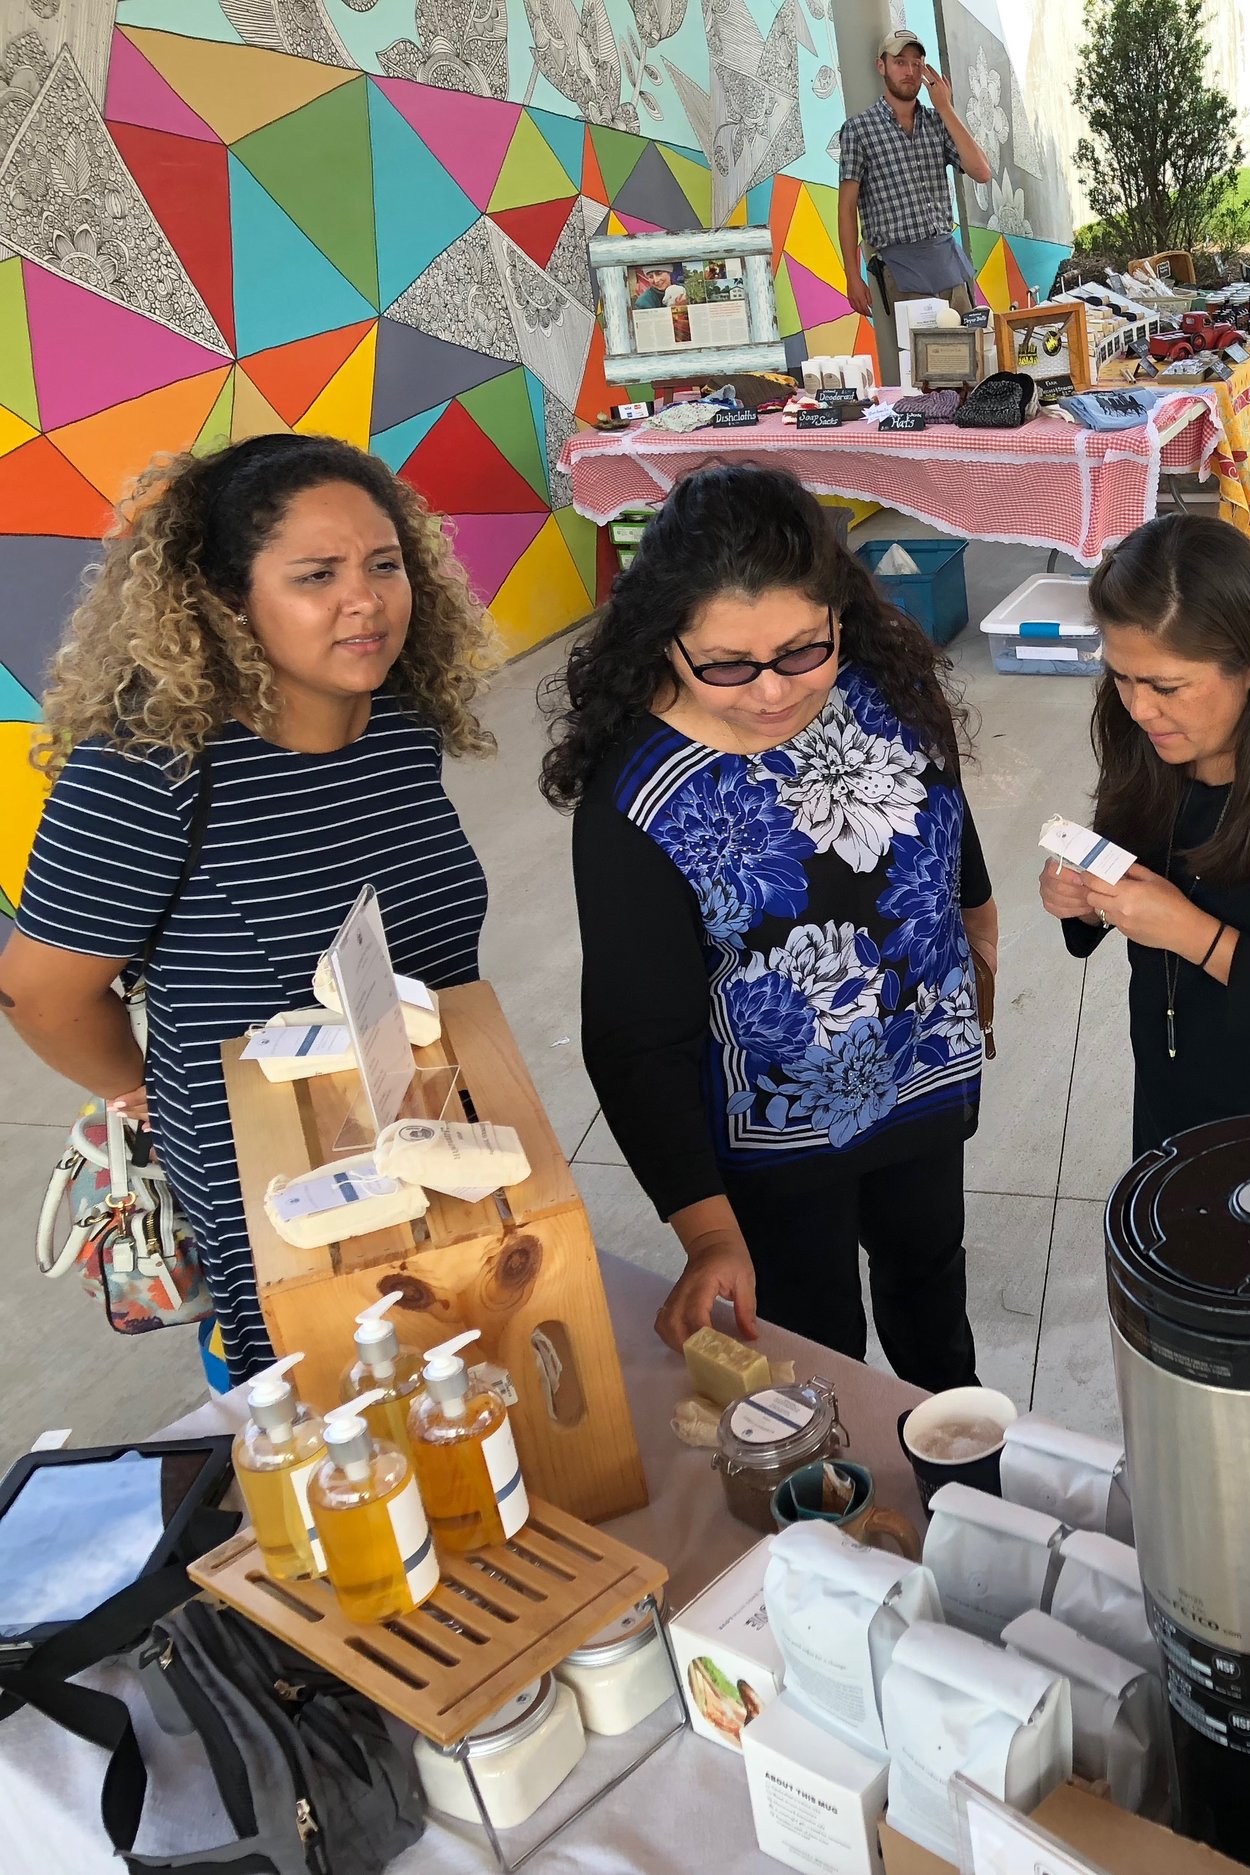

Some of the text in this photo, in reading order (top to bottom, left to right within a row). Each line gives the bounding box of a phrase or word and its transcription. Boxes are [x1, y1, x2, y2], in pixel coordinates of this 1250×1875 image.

[820, 391, 856, 402] Deodorant
[715, 410, 757, 424] Dishcloths
[799, 410, 820, 424] Soap
[815, 415, 839, 426] Sacks
[890, 414, 915, 429] Hats
[1215, 1657, 1236, 1675] NSF
[765, 1772, 838, 1815] ABOUT THIS MUG
